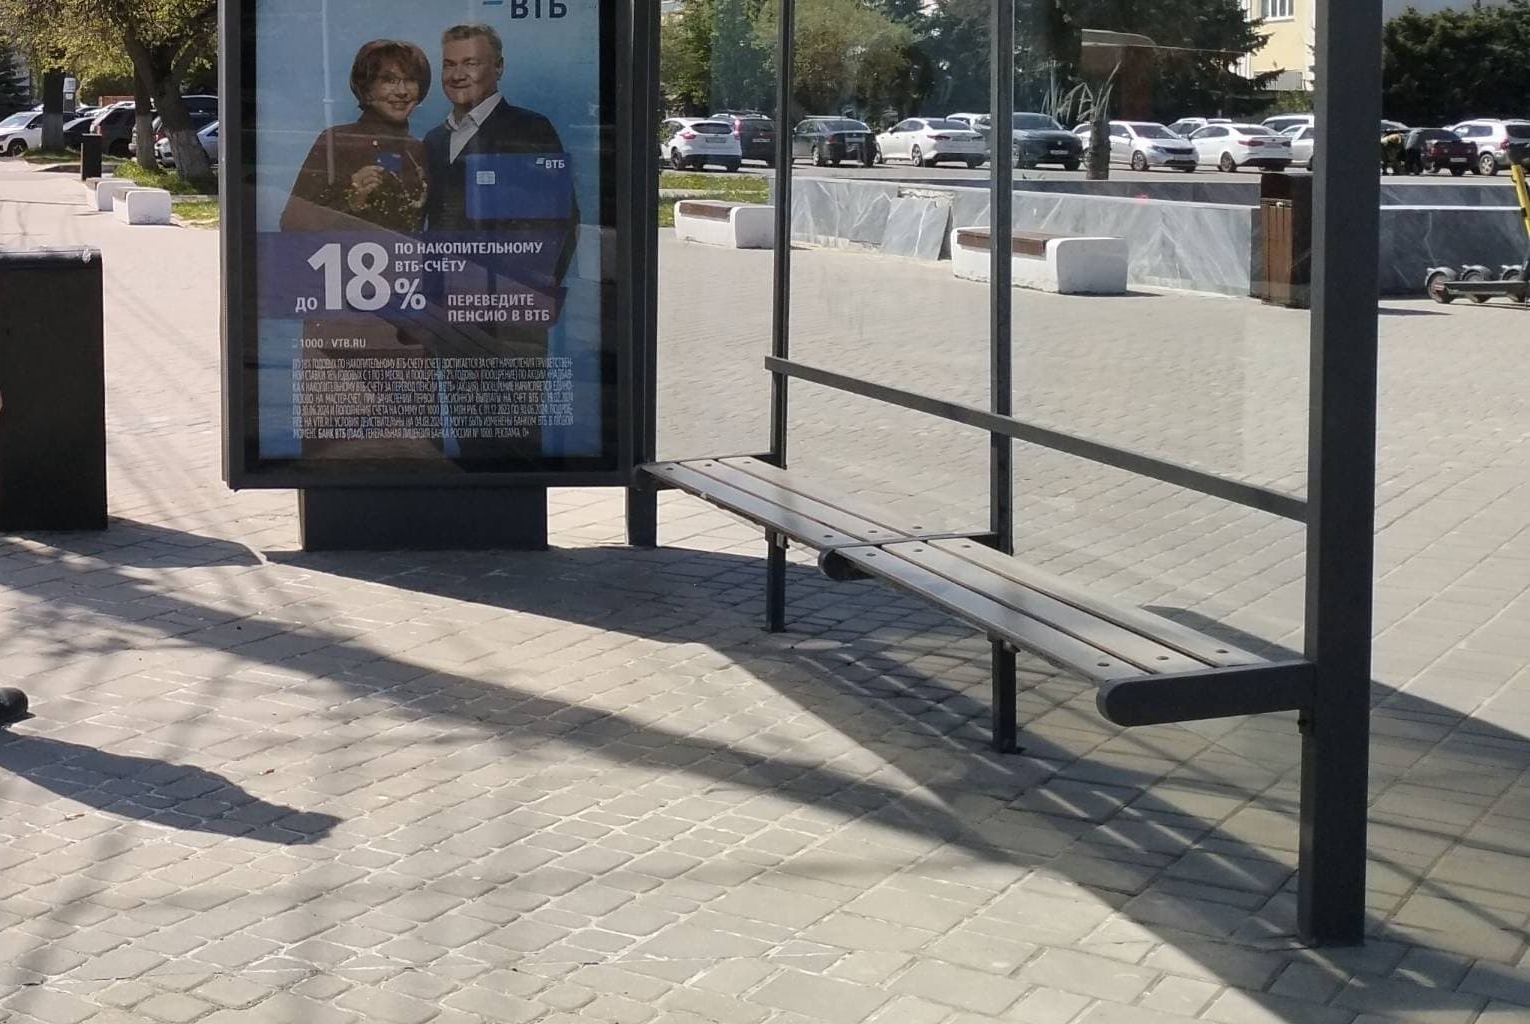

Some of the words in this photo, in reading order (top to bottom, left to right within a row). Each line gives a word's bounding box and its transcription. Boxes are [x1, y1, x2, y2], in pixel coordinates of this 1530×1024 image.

[545, 159, 566, 169] ВТБ
[395, 243, 413, 255] ПО
[418, 242, 543, 255] НАКОПИТЕЛЬНОМУ
[395, 258, 466, 273] ВТБ-СЧЁТУ
[448, 294, 535, 308] ПЕРЕВЕДИТЕ
[448, 310, 507, 323] ПЕНСИЮ
[512, 309, 521, 322] В
[525, 309, 551, 322] ВТБ
[300, 338, 324, 349] 1000
[331, 338, 366, 349] VTB.RU
